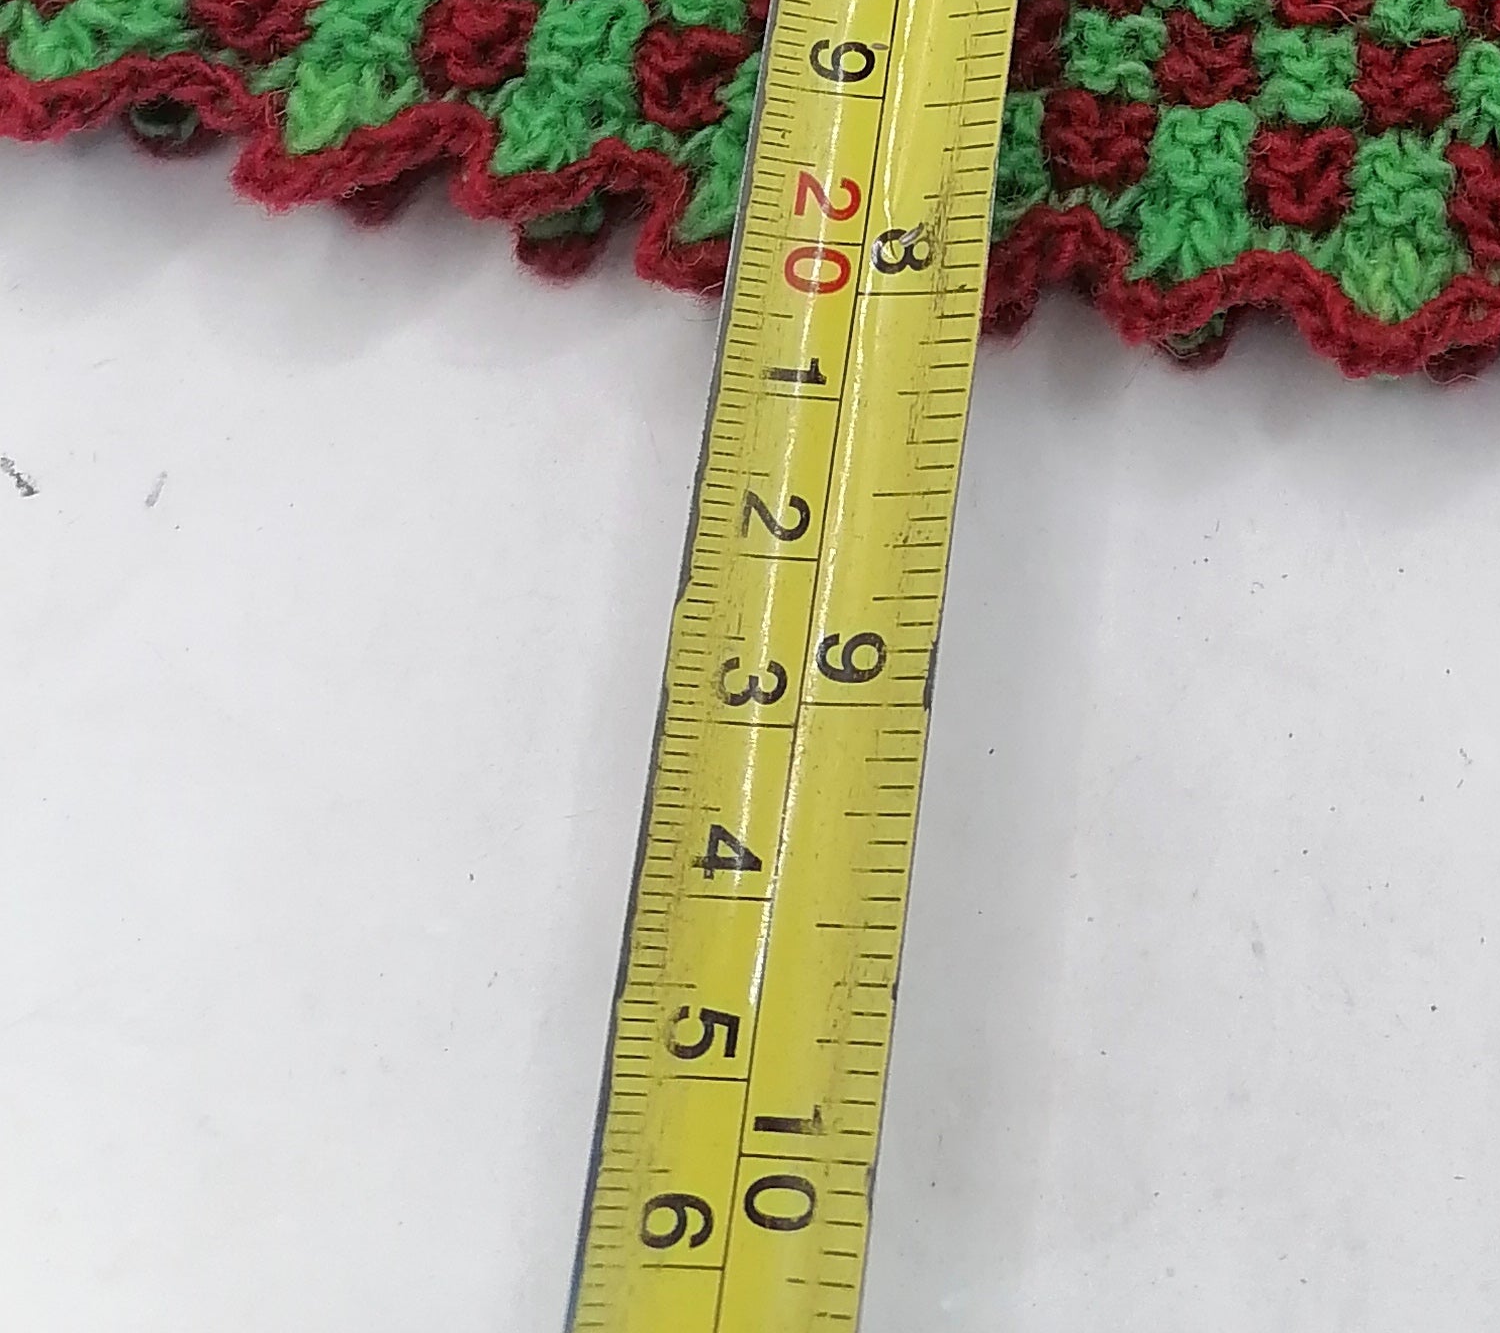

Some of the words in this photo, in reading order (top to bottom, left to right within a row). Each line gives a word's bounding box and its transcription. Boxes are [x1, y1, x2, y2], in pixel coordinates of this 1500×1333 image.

[809, 39, 876, 83] 9
[783, 169, 861, 295] 20
[870, 228, 931, 275] 8
[763, 357, 828, 386] 1
[742, 490, 811, 542] 2
[717, 656, 788, 706] 3
[816, 631, 887, 684] 9
[693, 823, 763, 879] 4
[665, 1004, 741, 1060] 5
[743, 1104, 822, 1232] 10
[641, 1191, 714, 1250] 6
